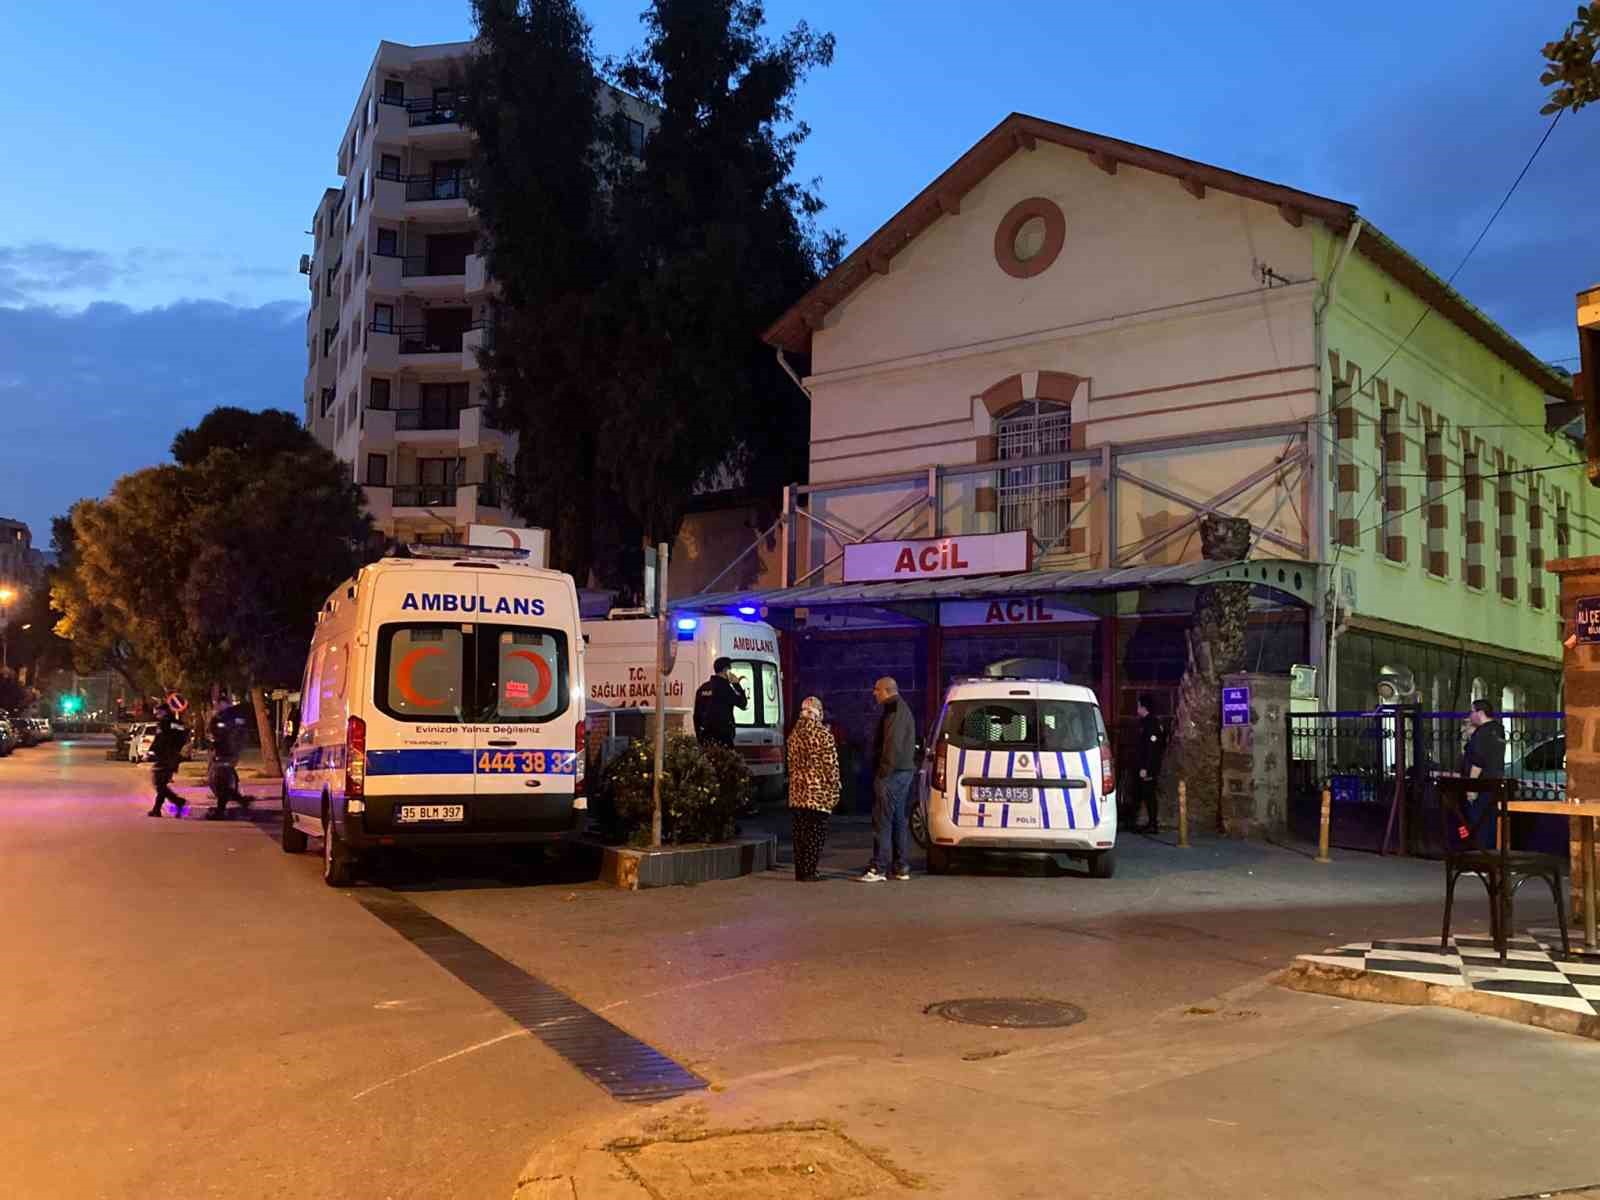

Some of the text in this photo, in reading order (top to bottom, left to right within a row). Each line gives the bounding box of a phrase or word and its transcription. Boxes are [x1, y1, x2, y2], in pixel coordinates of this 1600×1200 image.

[401, 592, 545, 616] AMBULANS
[733, 636, 773, 653] AMBULANS
[629, 667, 646, 681] T.C.
[591, 682, 627, 698] SAĞLIK
[629, 680, 683, 697] BAKALIĞI
[415, 725, 458, 734] Evinizde
[493, 725, 540, 735] Değilsiniz
[479, 751, 516, 773] 444
[521, 751, 545, 773] 38
[994, 787, 1004, 798] A
[403, 807, 461, 818] 35 BLM 397
